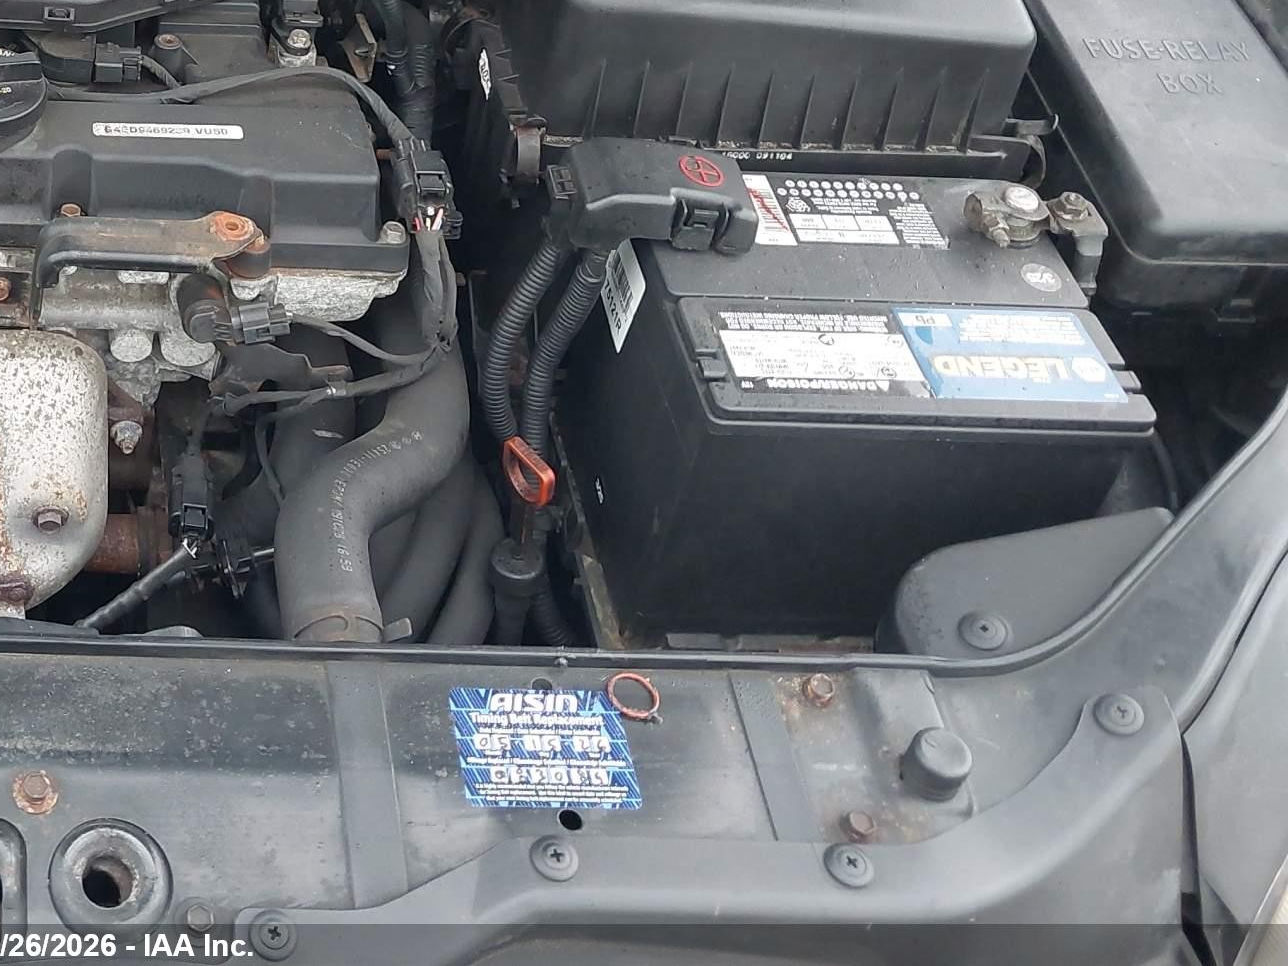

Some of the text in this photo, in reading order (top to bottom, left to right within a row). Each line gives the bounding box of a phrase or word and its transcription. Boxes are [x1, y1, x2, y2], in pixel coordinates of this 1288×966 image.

[1157, 72, 1223, 95] BOX
[929, 354, 1068, 381] LEGEND
[489, 693, 578, 712] AISIN
[471, 712, 604, 726] Timing Belt Replacement
